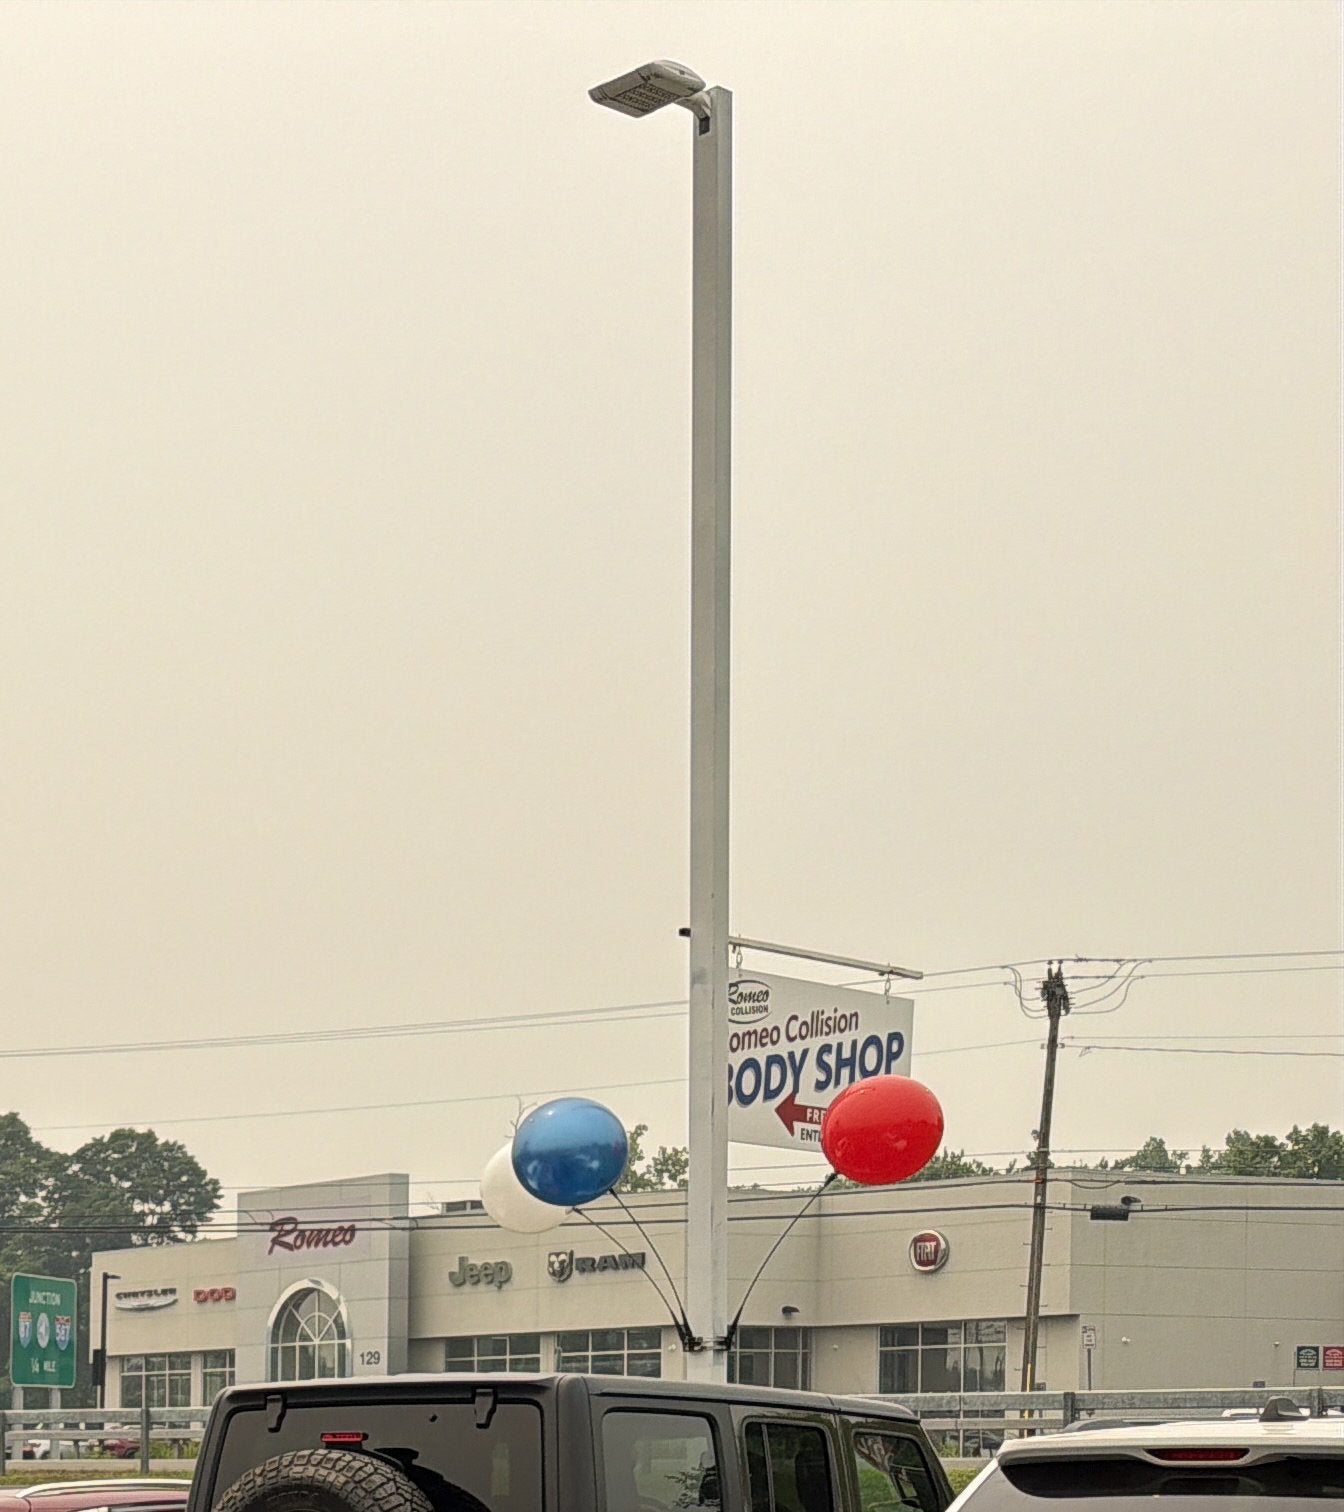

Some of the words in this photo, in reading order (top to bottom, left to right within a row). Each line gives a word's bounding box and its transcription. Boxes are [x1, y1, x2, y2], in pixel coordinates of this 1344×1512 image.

[730, 1003, 770, 1016] COLLISION
[728, 1024, 781, 1054] omeo
[786, 1007, 859, 1043] Collision
[815, 1031, 904, 1092] SHOP
[267, 1216, 357, 1256] Romeo
[448, 1256, 512, 1290] Jeep
[575, 1252, 646, 1274] RAM
[360, 1351, 381, 1365] 129
